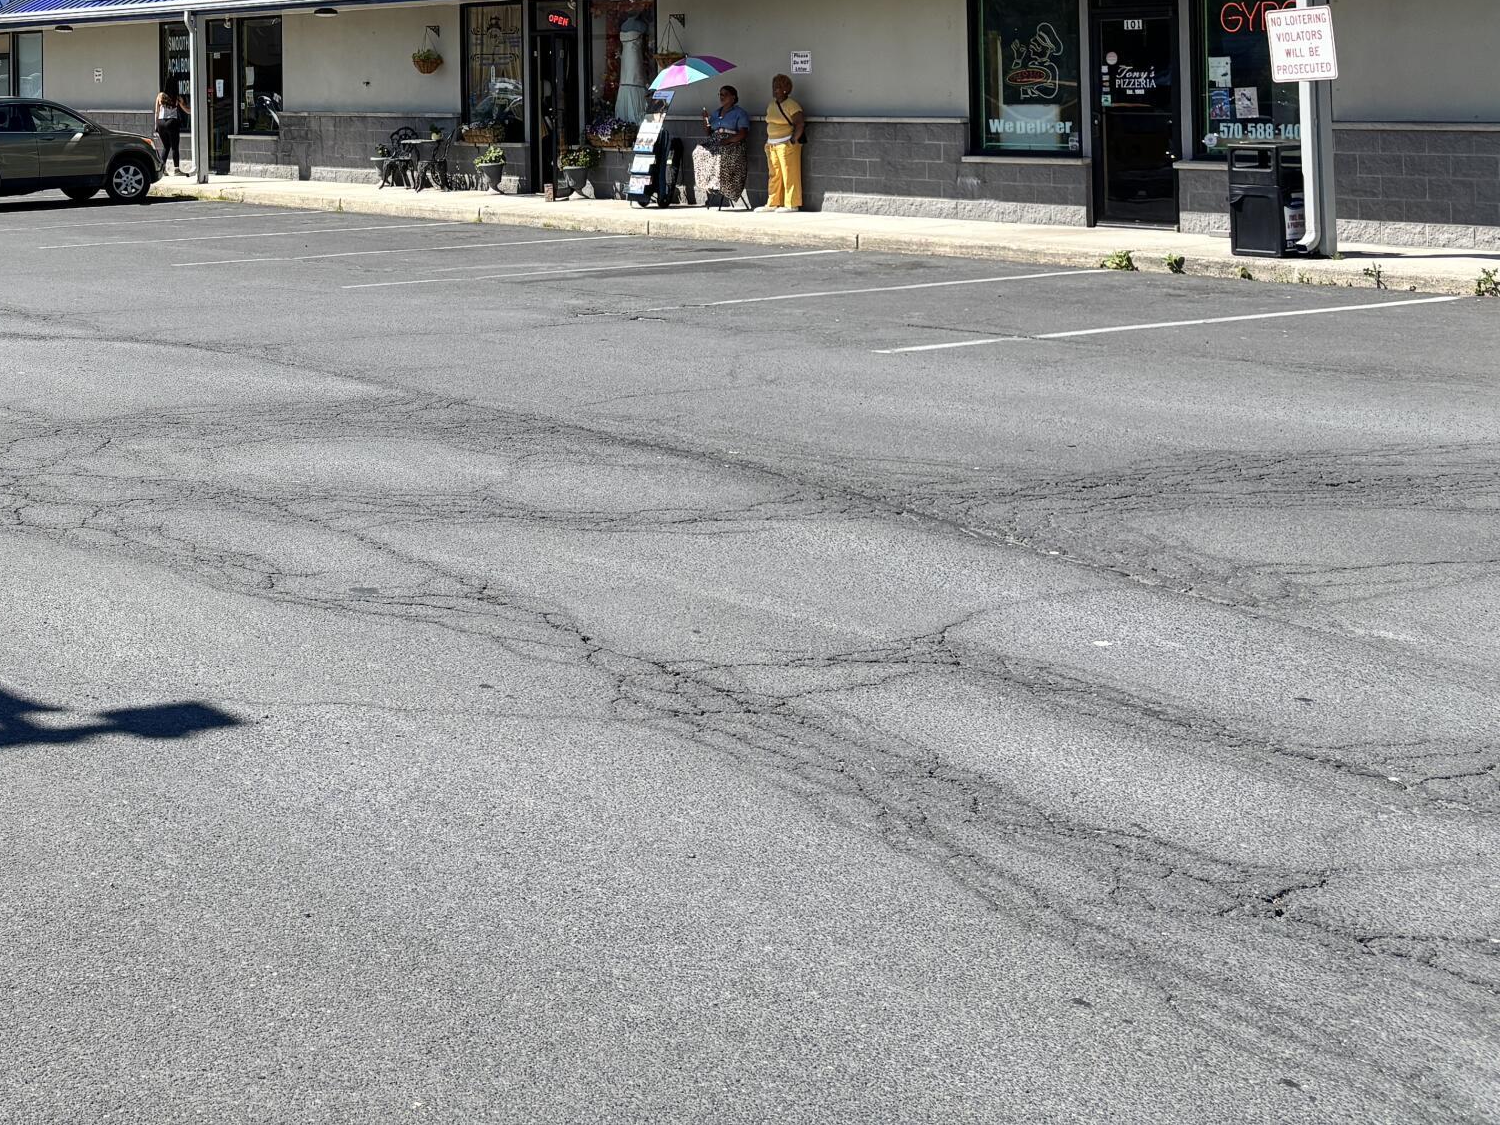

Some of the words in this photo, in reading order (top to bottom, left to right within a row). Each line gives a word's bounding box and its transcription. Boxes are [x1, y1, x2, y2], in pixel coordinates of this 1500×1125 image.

[548, 14, 569, 27] OPEN
[1220, 0, 1297, 32] GYR
[1270, 16, 1282, 27] NO
[1284, 12, 1327, 26] LOITERING
[1124, 20, 1142, 29] 101
[1276, 29, 1323, 42] VIOLATORS
[168, 36, 190, 51] SMOOTH
[1284, 47, 1306, 58] WILL
[1308, 46, 1321, 57] BE
[1116, 65, 1156, 80] Tony's
[1276, 62, 1332, 75] PROSECUTED
[178, 80, 190, 95] MOR
[1115, 78, 1156, 88] PIZZERIA
[988, 118, 1014, 133] We
